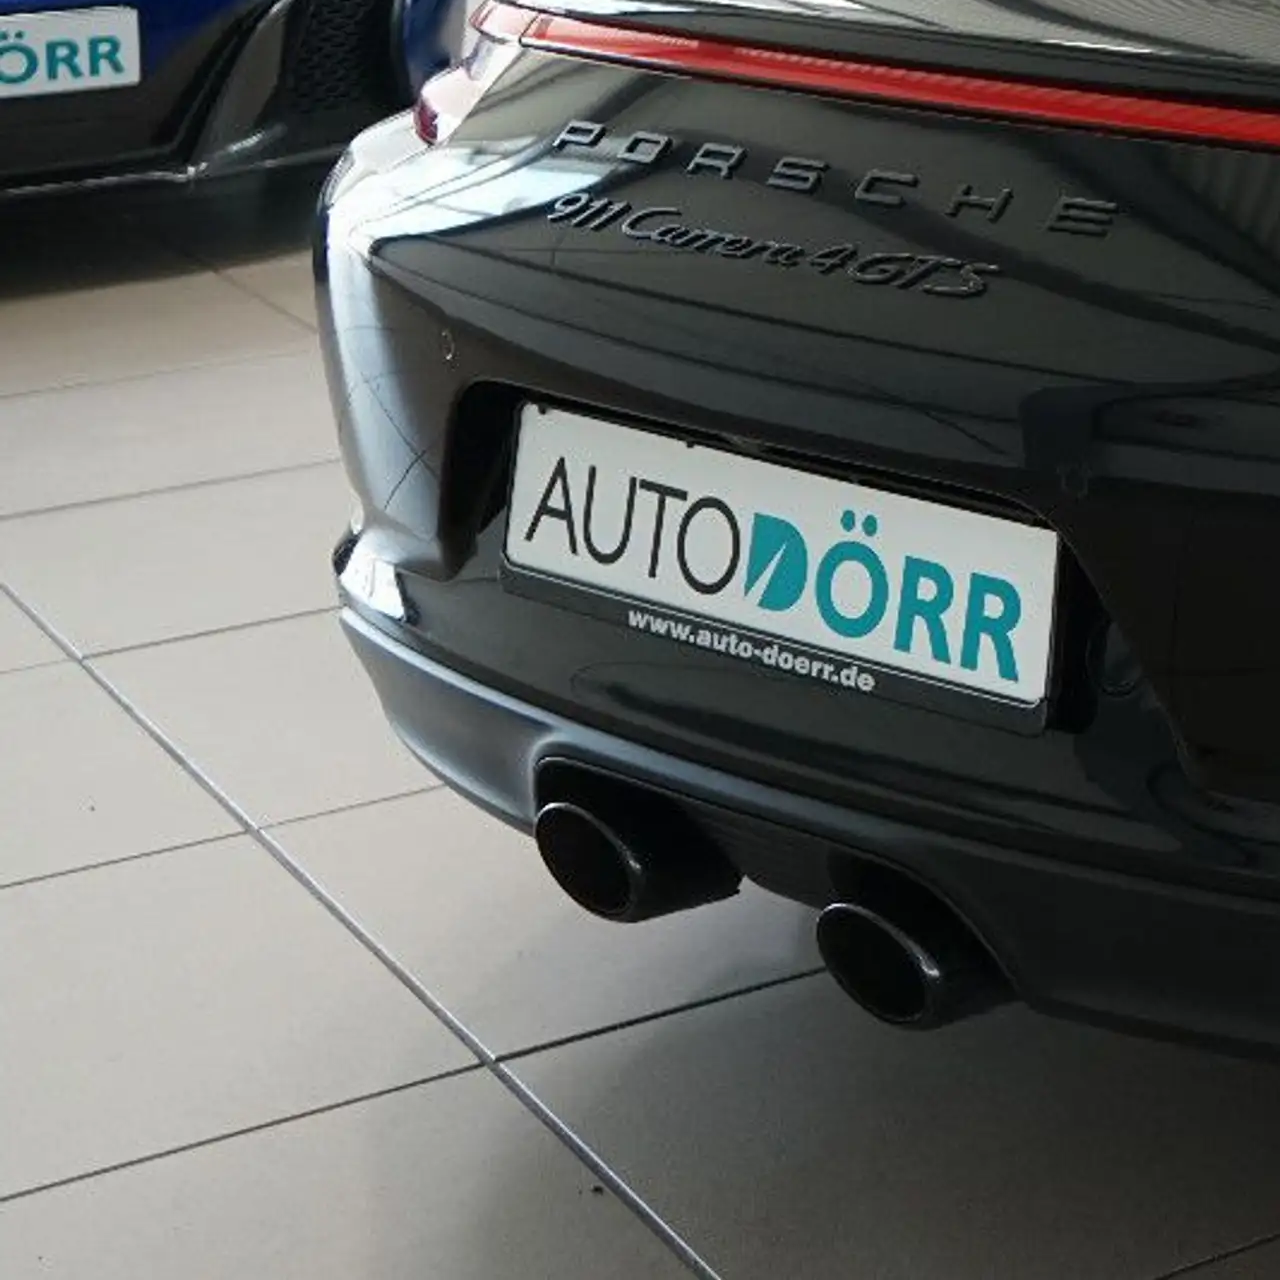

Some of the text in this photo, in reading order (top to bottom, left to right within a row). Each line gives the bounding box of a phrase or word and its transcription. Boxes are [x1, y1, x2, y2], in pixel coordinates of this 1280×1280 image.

[552, 119, 1118, 238] PORSCHE
[547, 191, 633, 232] 911
[622, 206, 806, 269] Carrera
[627, 609, 877, 693] www.auto-doerr.de
